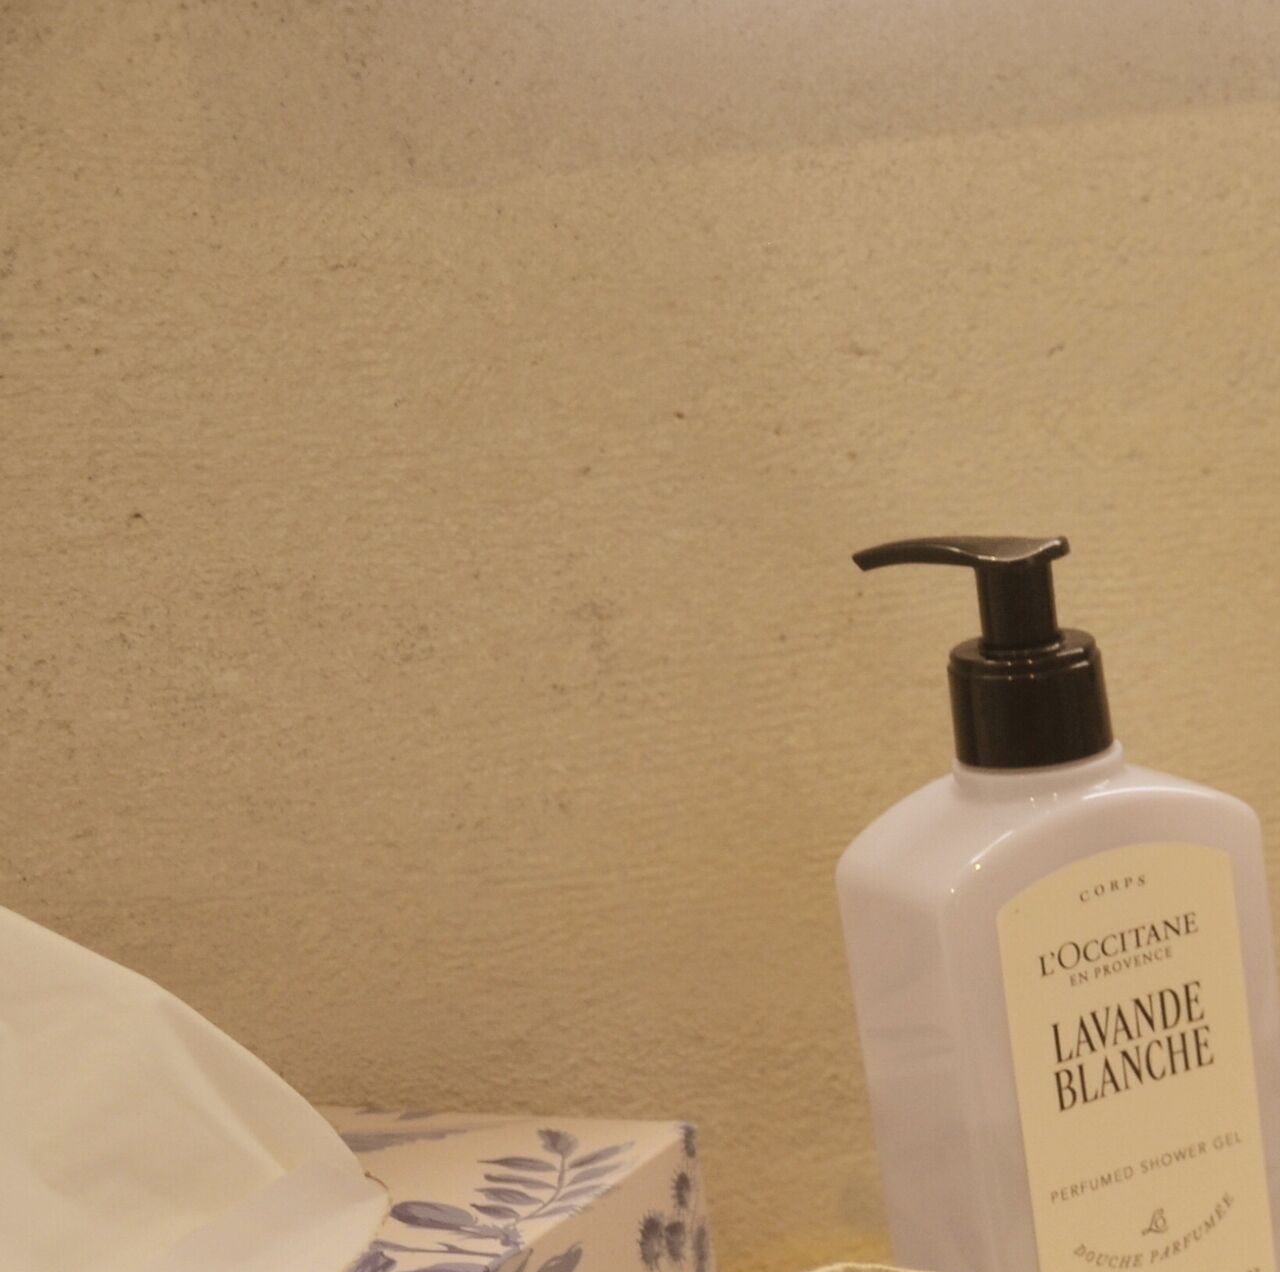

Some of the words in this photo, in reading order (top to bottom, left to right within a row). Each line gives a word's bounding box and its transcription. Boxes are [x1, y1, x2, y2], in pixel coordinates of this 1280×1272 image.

[1079, 874, 1146, 903] CORPS
[1038, 911, 1199, 978] L'OCCITANE
[1069, 971, 1089, 987] EN
[1094, 946, 1173, 979] PROVENCE
[1052, 980, 1205, 1064] LAVANDE
[1054, 1025, 1215, 1113] BLANCHE
[1050, 1165, 1135, 1205] PERFUMED
[1139, 1141, 1207, 1175] SHOWER
[1212, 1131, 1243, 1151] GEL
[1072, 1243, 1144, 1270] DOUCHE
